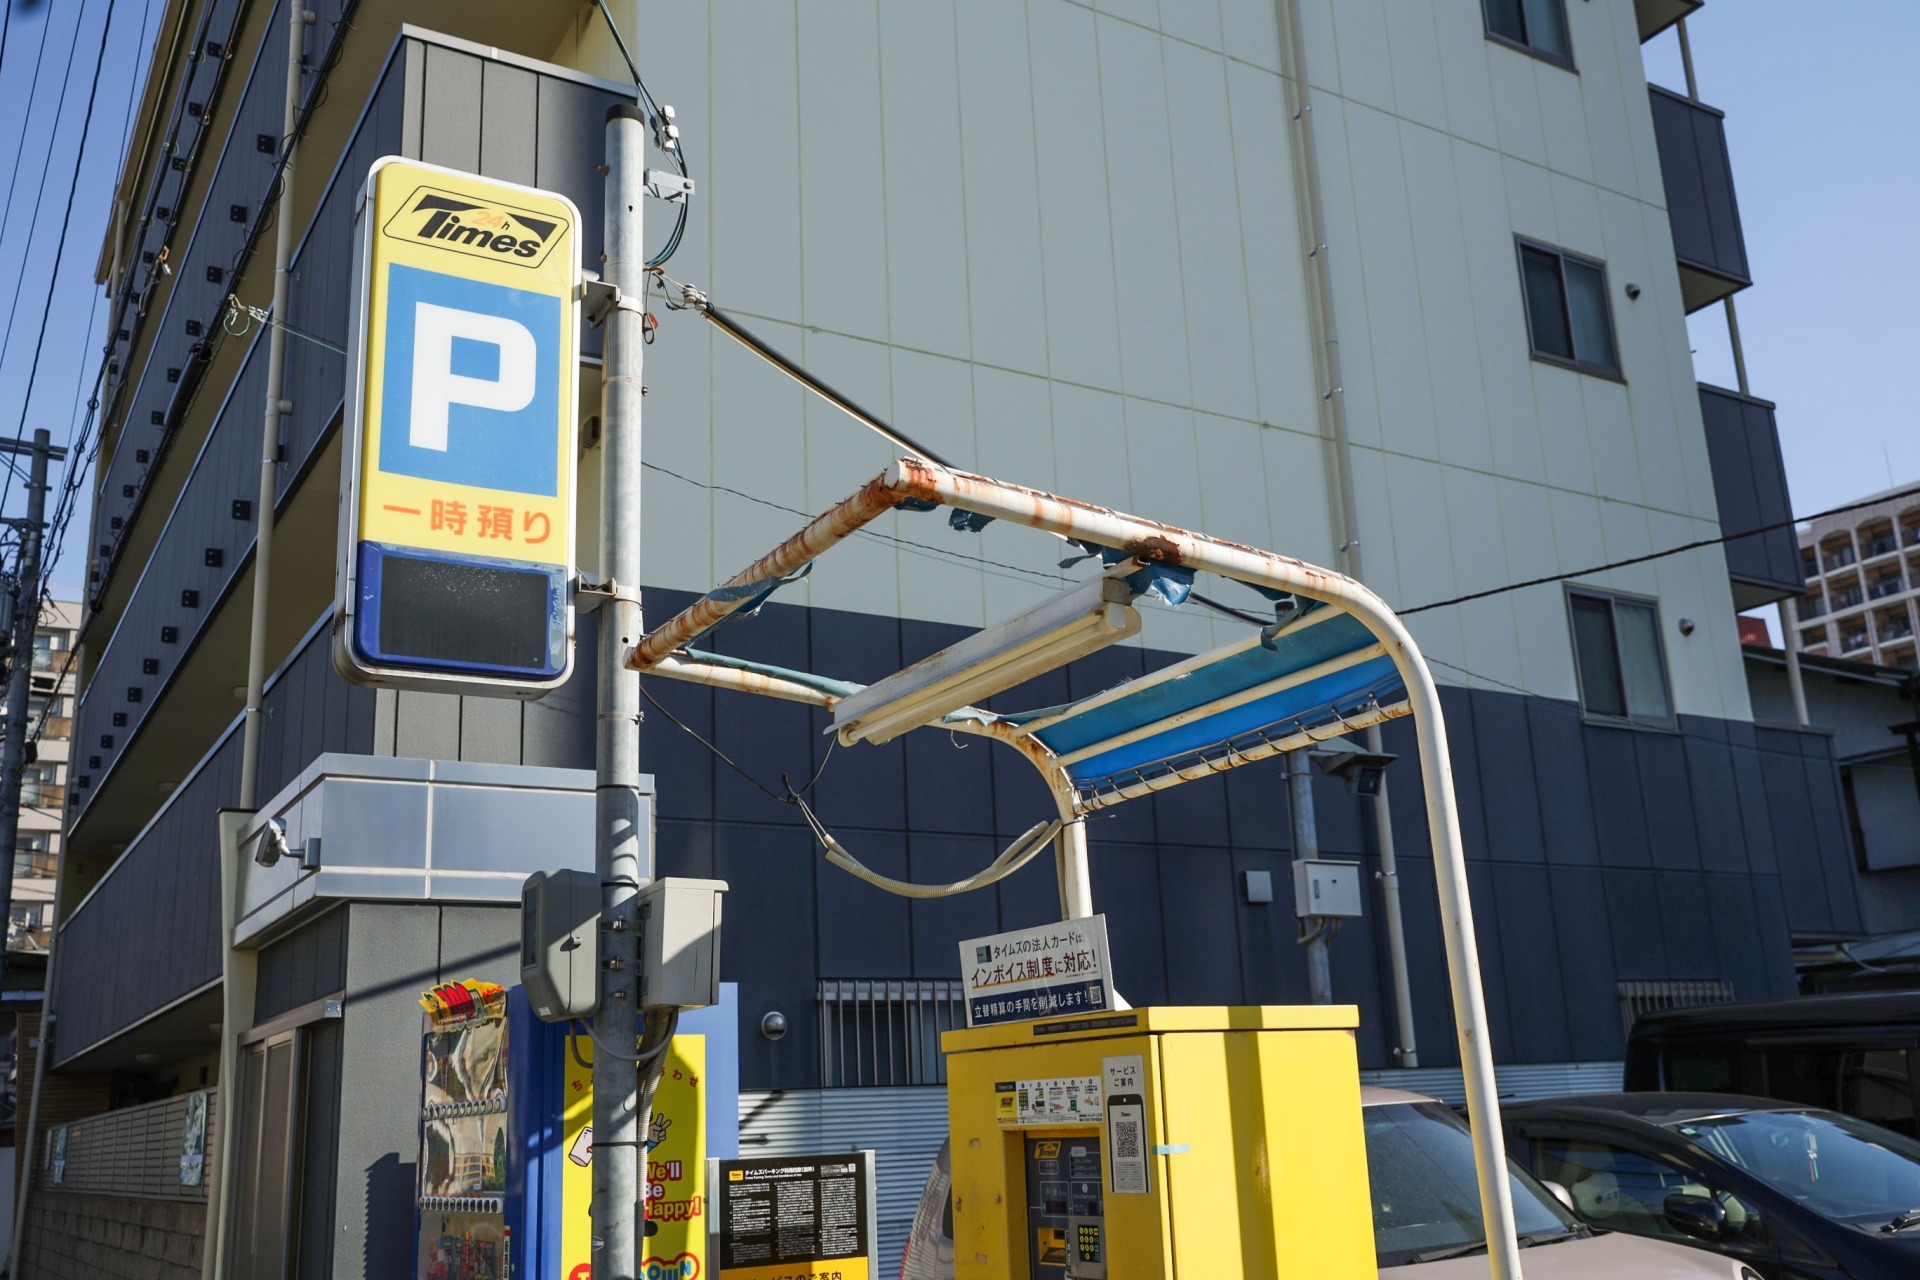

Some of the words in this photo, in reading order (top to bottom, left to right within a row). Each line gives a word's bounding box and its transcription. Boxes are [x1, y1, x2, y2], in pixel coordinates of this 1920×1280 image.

[417, 211, 541, 258] Times
[409, 301, 537, 453] P
[383, 498, 552, 544] 一時預り
[994, 932, 1082, 959] タイムズの法人カードは
[971, 949, 1097, 987] インボイス制度に対応!
[974, 991, 1088, 1018] 立替精算の手間を削減します!
[1110, 1066, 1136, 1075] サービス
[1114, 1078, 1134, 1087] ご案内
[1039, 1147, 1057, 1157] Times
